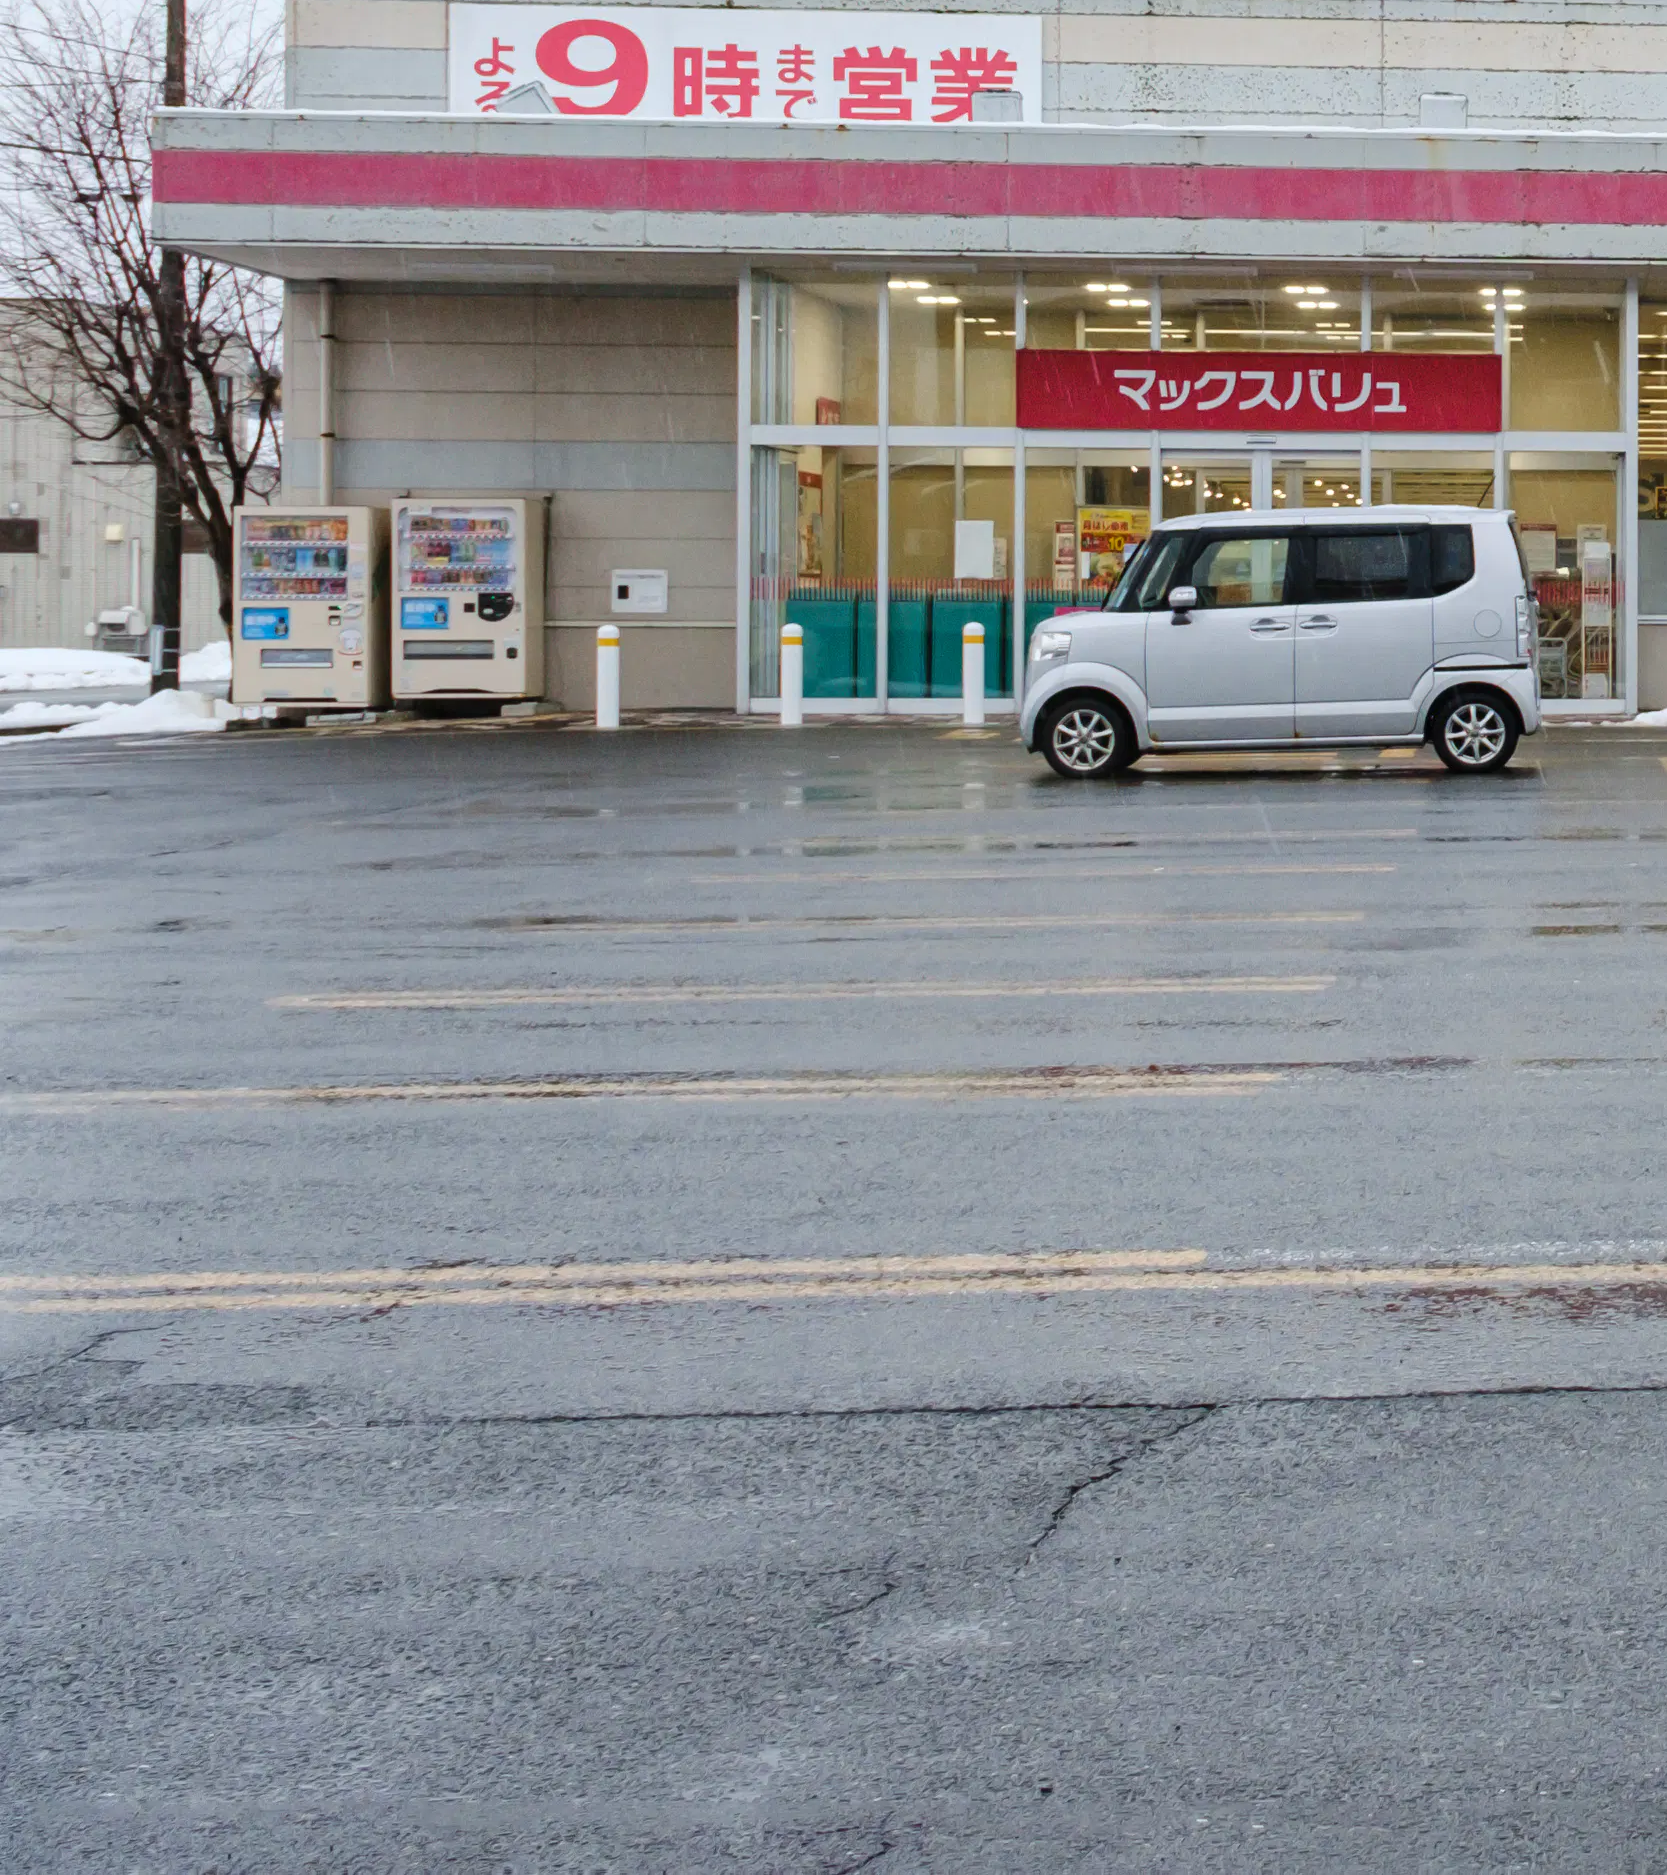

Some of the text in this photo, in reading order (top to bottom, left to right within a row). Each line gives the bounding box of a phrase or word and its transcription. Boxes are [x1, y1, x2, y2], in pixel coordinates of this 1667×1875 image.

[1113, 369, 1407, 413] マックスバリュ
